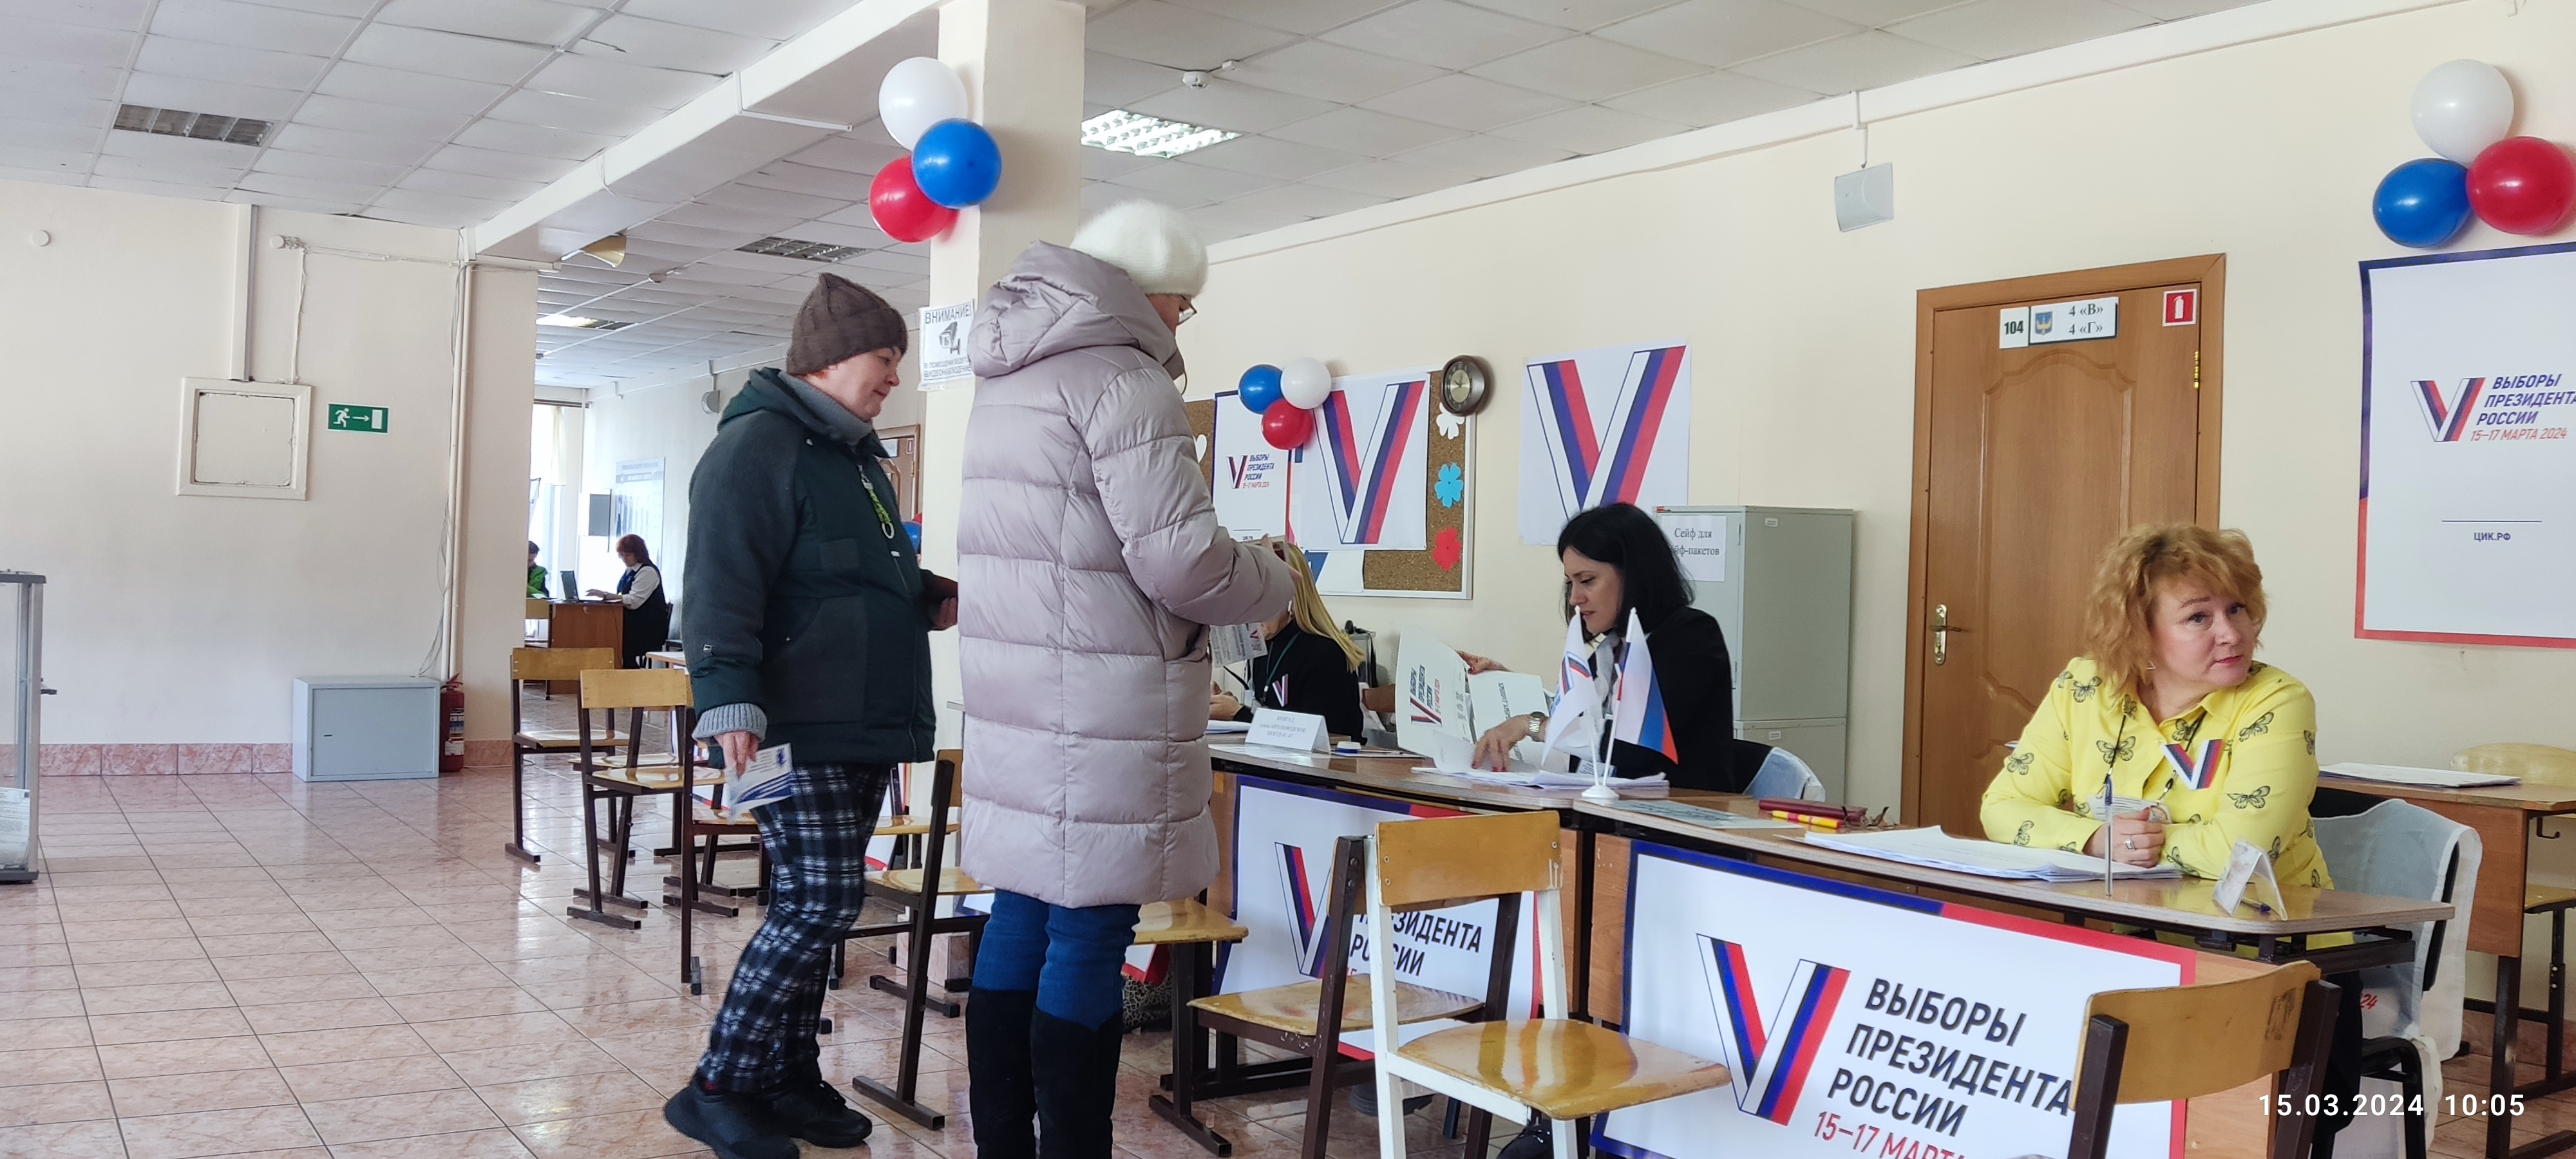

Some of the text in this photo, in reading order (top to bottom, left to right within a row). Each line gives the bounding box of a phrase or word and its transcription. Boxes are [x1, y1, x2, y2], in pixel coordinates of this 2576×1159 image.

[2069, 303, 2104, 317] 4 «В»
[2003, 321, 2025, 335] 104
[2069, 321, 2103, 335] 4 «Г»
[2492, 373, 2562, 390] ВЫБОРЫ
[2476, 411, 2539, 426] РОССИИ
[2501, 428, 2539, 440] МАРТА
[2539, 428, 2568, 439] 2024
[1674, 528, 1696, 540] Сейф
[2474, 532, 2511, 542] ЦИК.РФ
[1674, 545, 1719, 557] йф-пакетов
[1359, 911, 1482, 953] ЗИДЕНТА
[2360, 994, 2378, 1010] 24
[1864, 978, 2027, 1046] ВЫБОРЫ
[1846, 1024, 2072, 1117] ПРЕЗИДЕНТА
[1827, 1068, 1969, 1137] РОССИИ
[1879, 1132, 1965, 1159] МАР
